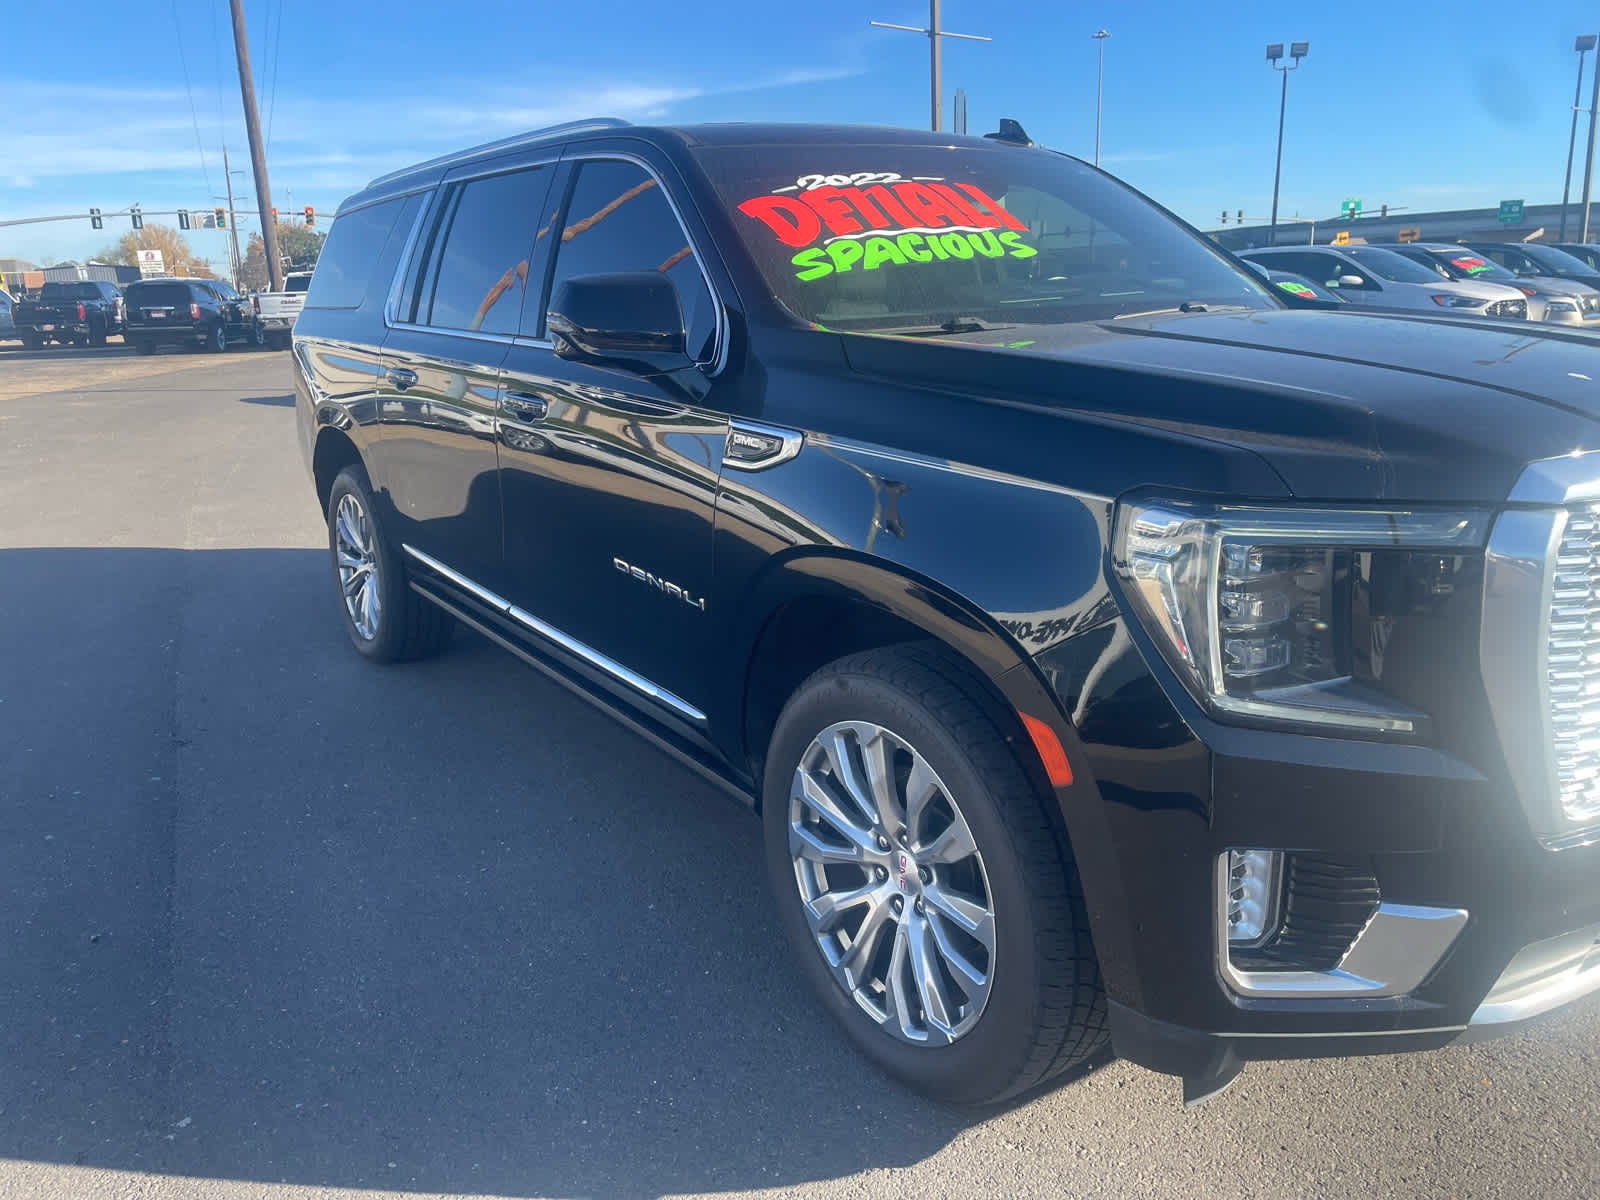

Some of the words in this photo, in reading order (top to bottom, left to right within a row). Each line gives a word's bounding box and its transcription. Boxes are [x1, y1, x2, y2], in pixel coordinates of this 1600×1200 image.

[797, 172, 903, 191] 2022
[737, 181, 1031, 248] DENALI
[791, 230, 1038, 282] SPACIOUS
[613, 556, 705, 612] DENALI
[899, 855, 907, 892] GMC
